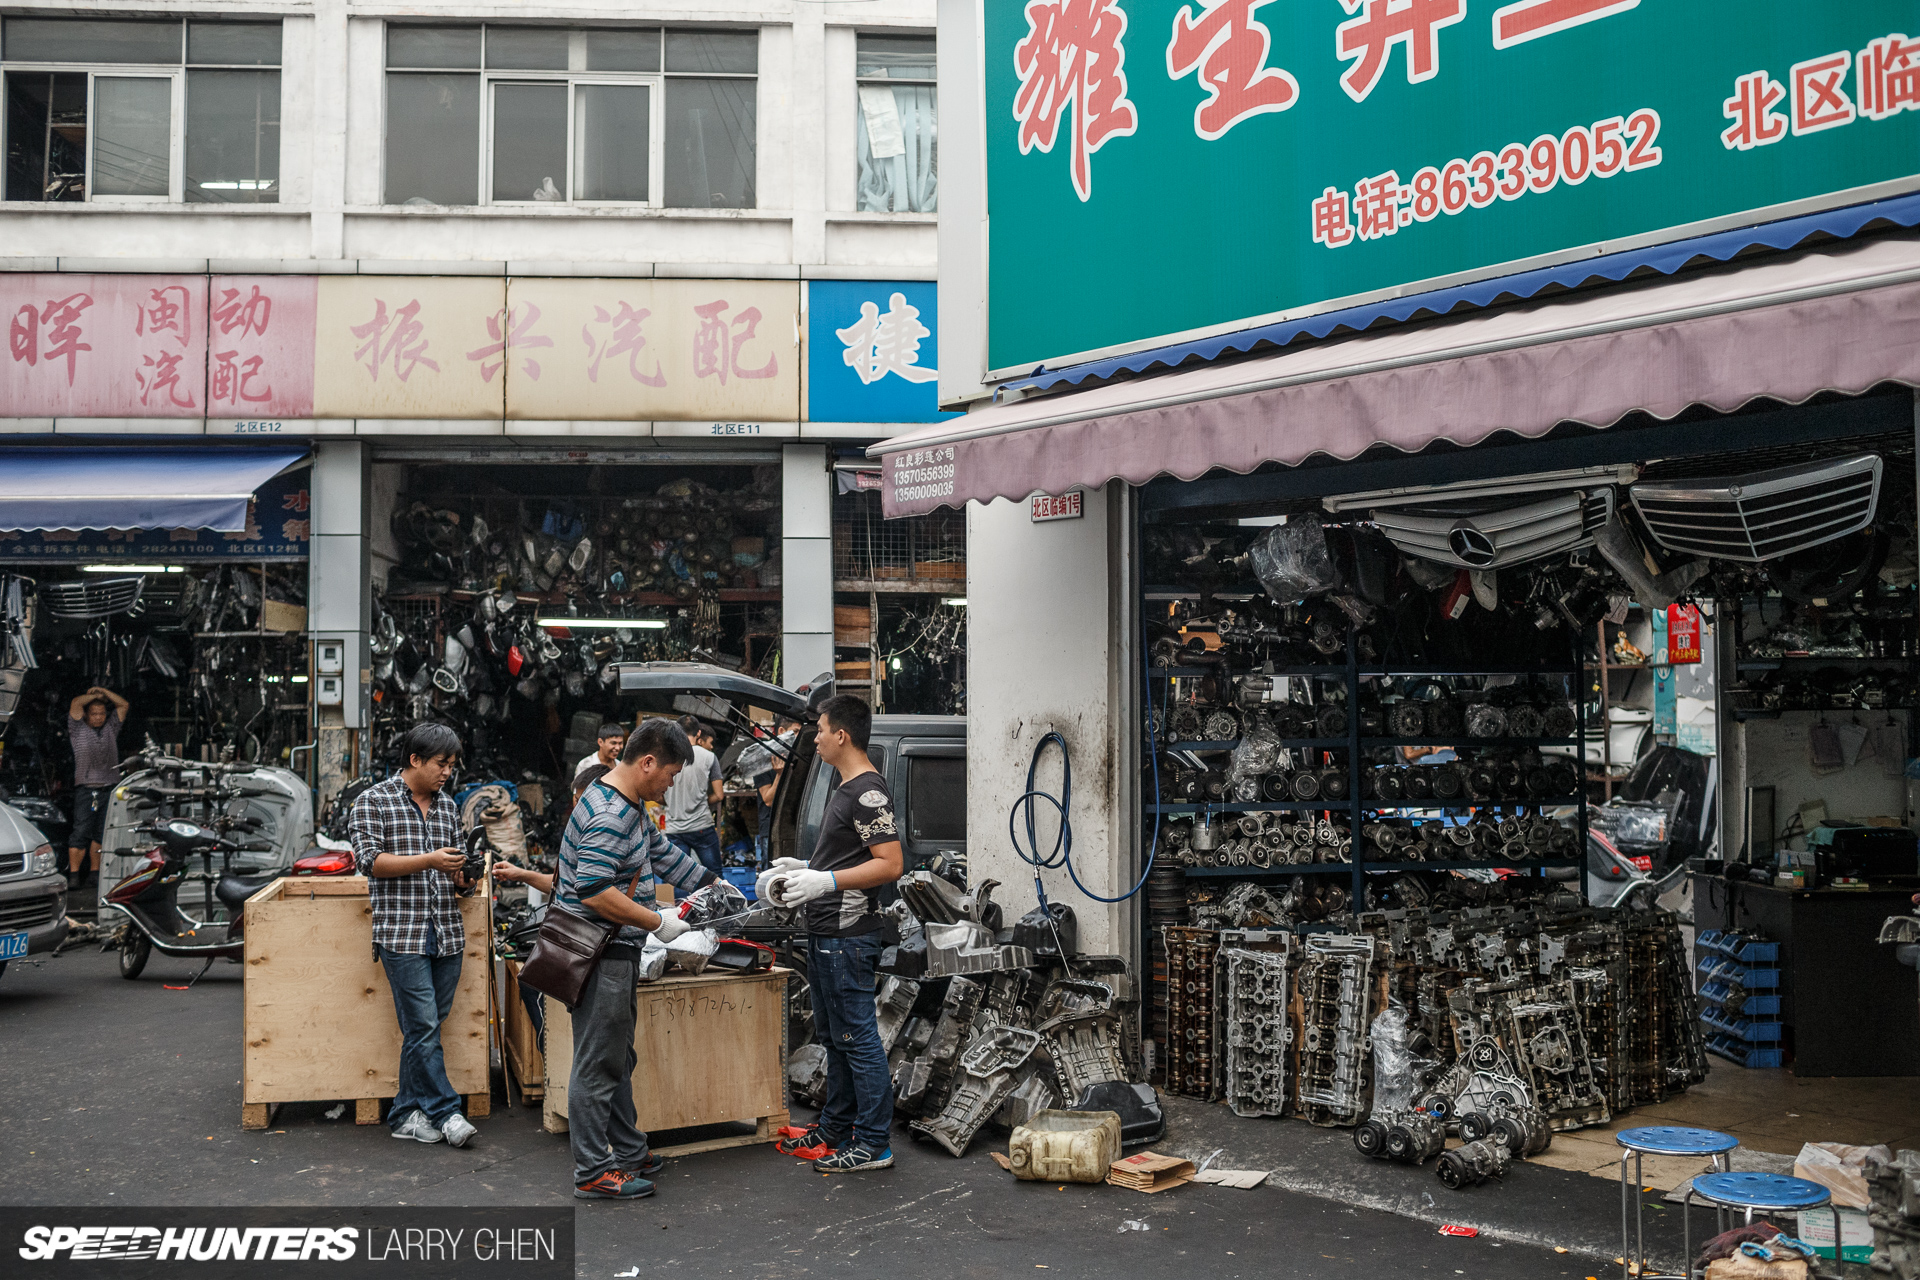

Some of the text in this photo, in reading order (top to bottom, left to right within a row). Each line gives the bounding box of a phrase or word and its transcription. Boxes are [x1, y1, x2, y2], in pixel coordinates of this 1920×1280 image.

[1721, 34, 1920, 150] 北区临
[350, 297, 778, 388] 振兴汽配
[835, 291, 937, 385] 捷
[234, 421, 282, 433] 北区E12
[711, 423, 760, 435] 北区E11
[894, 463, 955, 485] 13570556399
[894, 480, 954, 502] 13560009035
[1032, 494, 1081, 517] 北区临编1号
